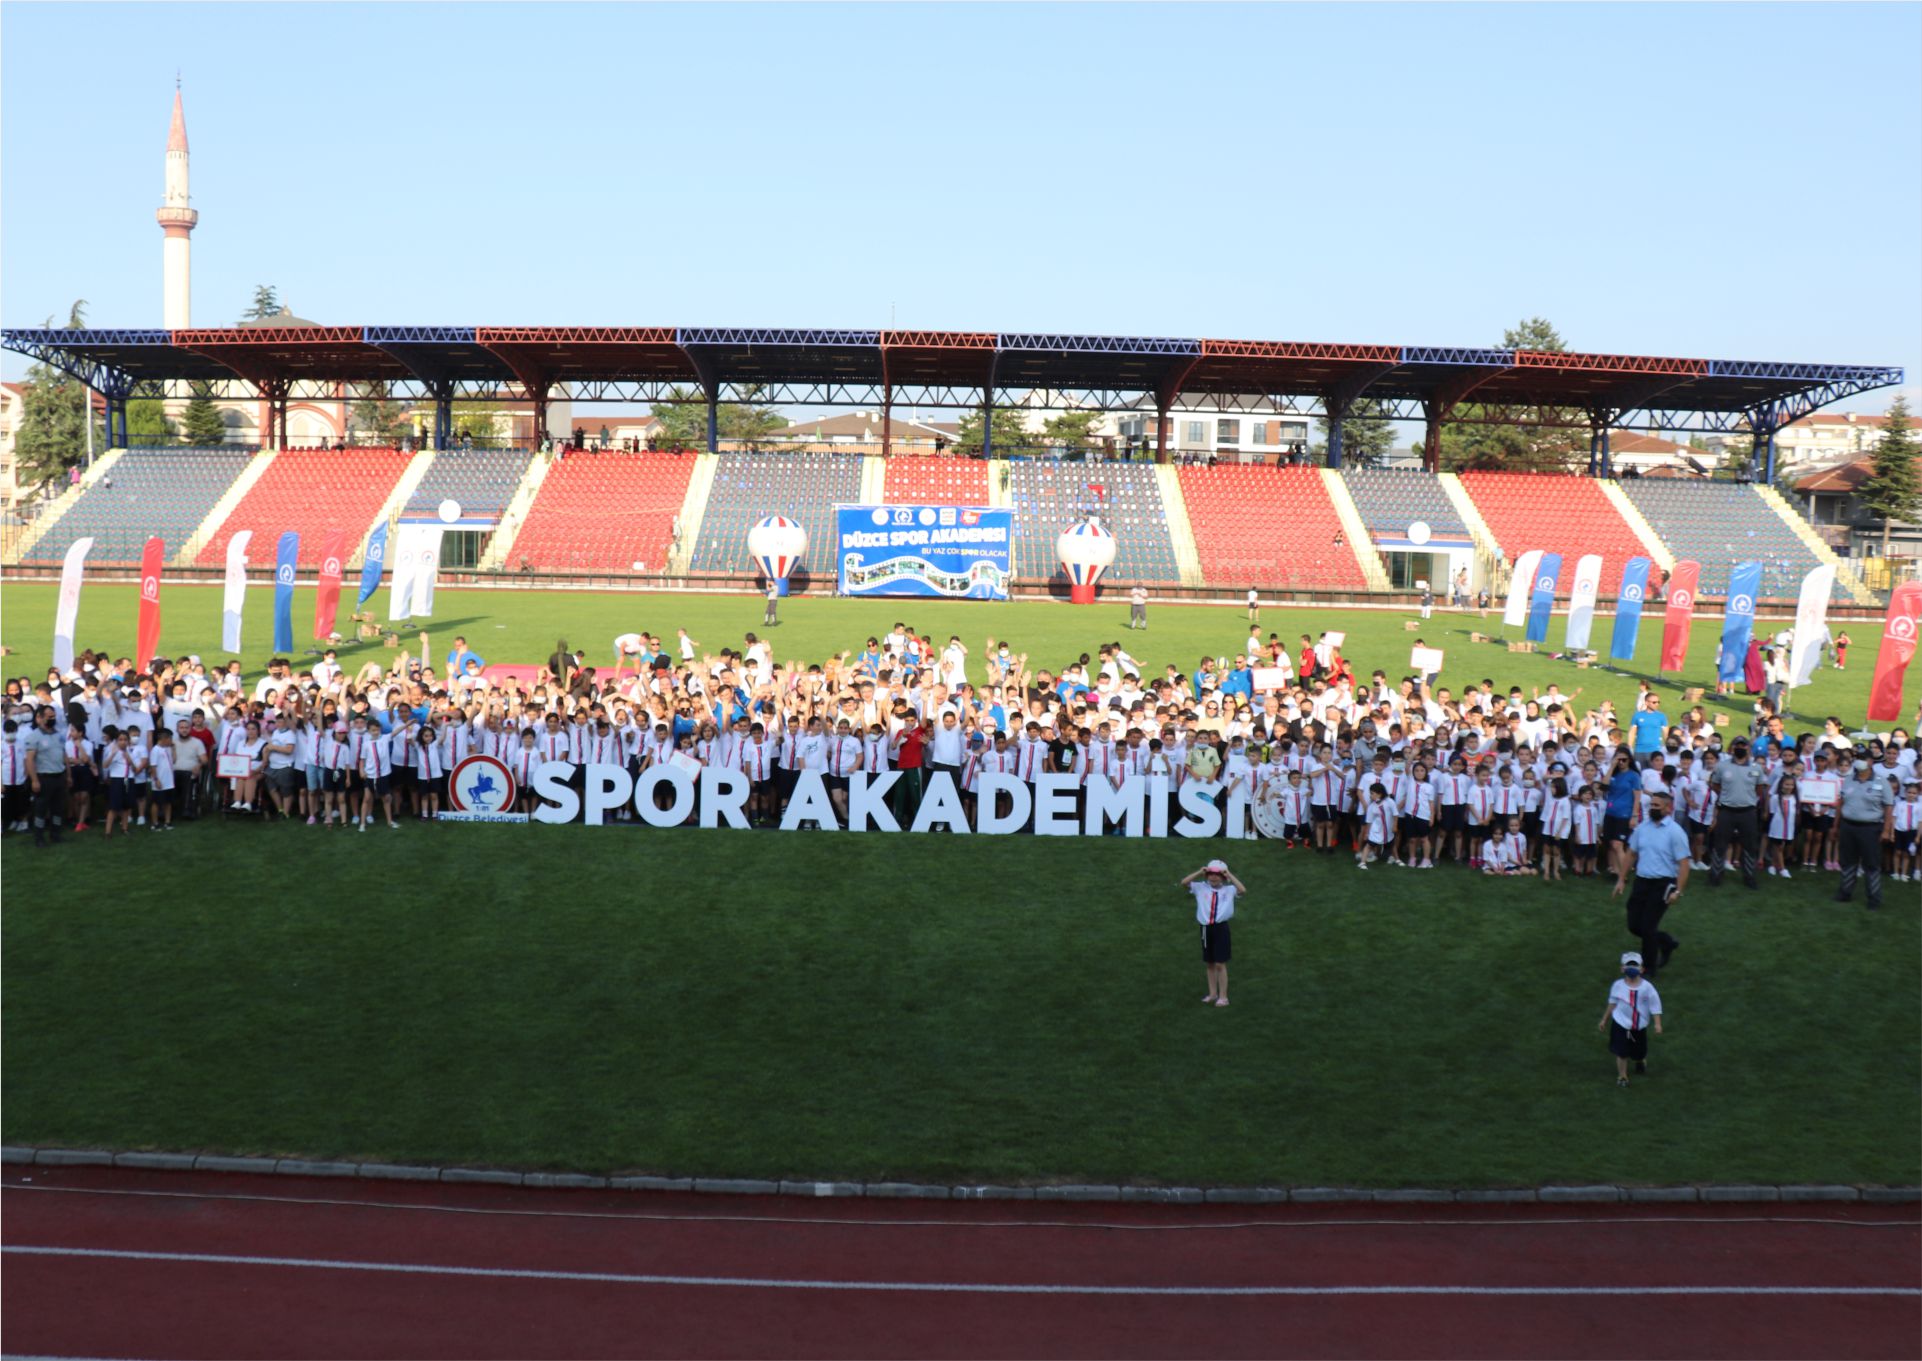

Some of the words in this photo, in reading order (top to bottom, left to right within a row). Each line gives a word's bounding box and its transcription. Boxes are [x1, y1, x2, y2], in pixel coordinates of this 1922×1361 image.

[842, 530, 889, 549] DÜZCE
[890, 530, 930, 546] SPOR
[932, 547, 946, 556] YAZ
[961, 548, 979, 556] SPOR
[979, 549, 1008, 558] OLACAK
[532, 760, 752, 829] SPOR
